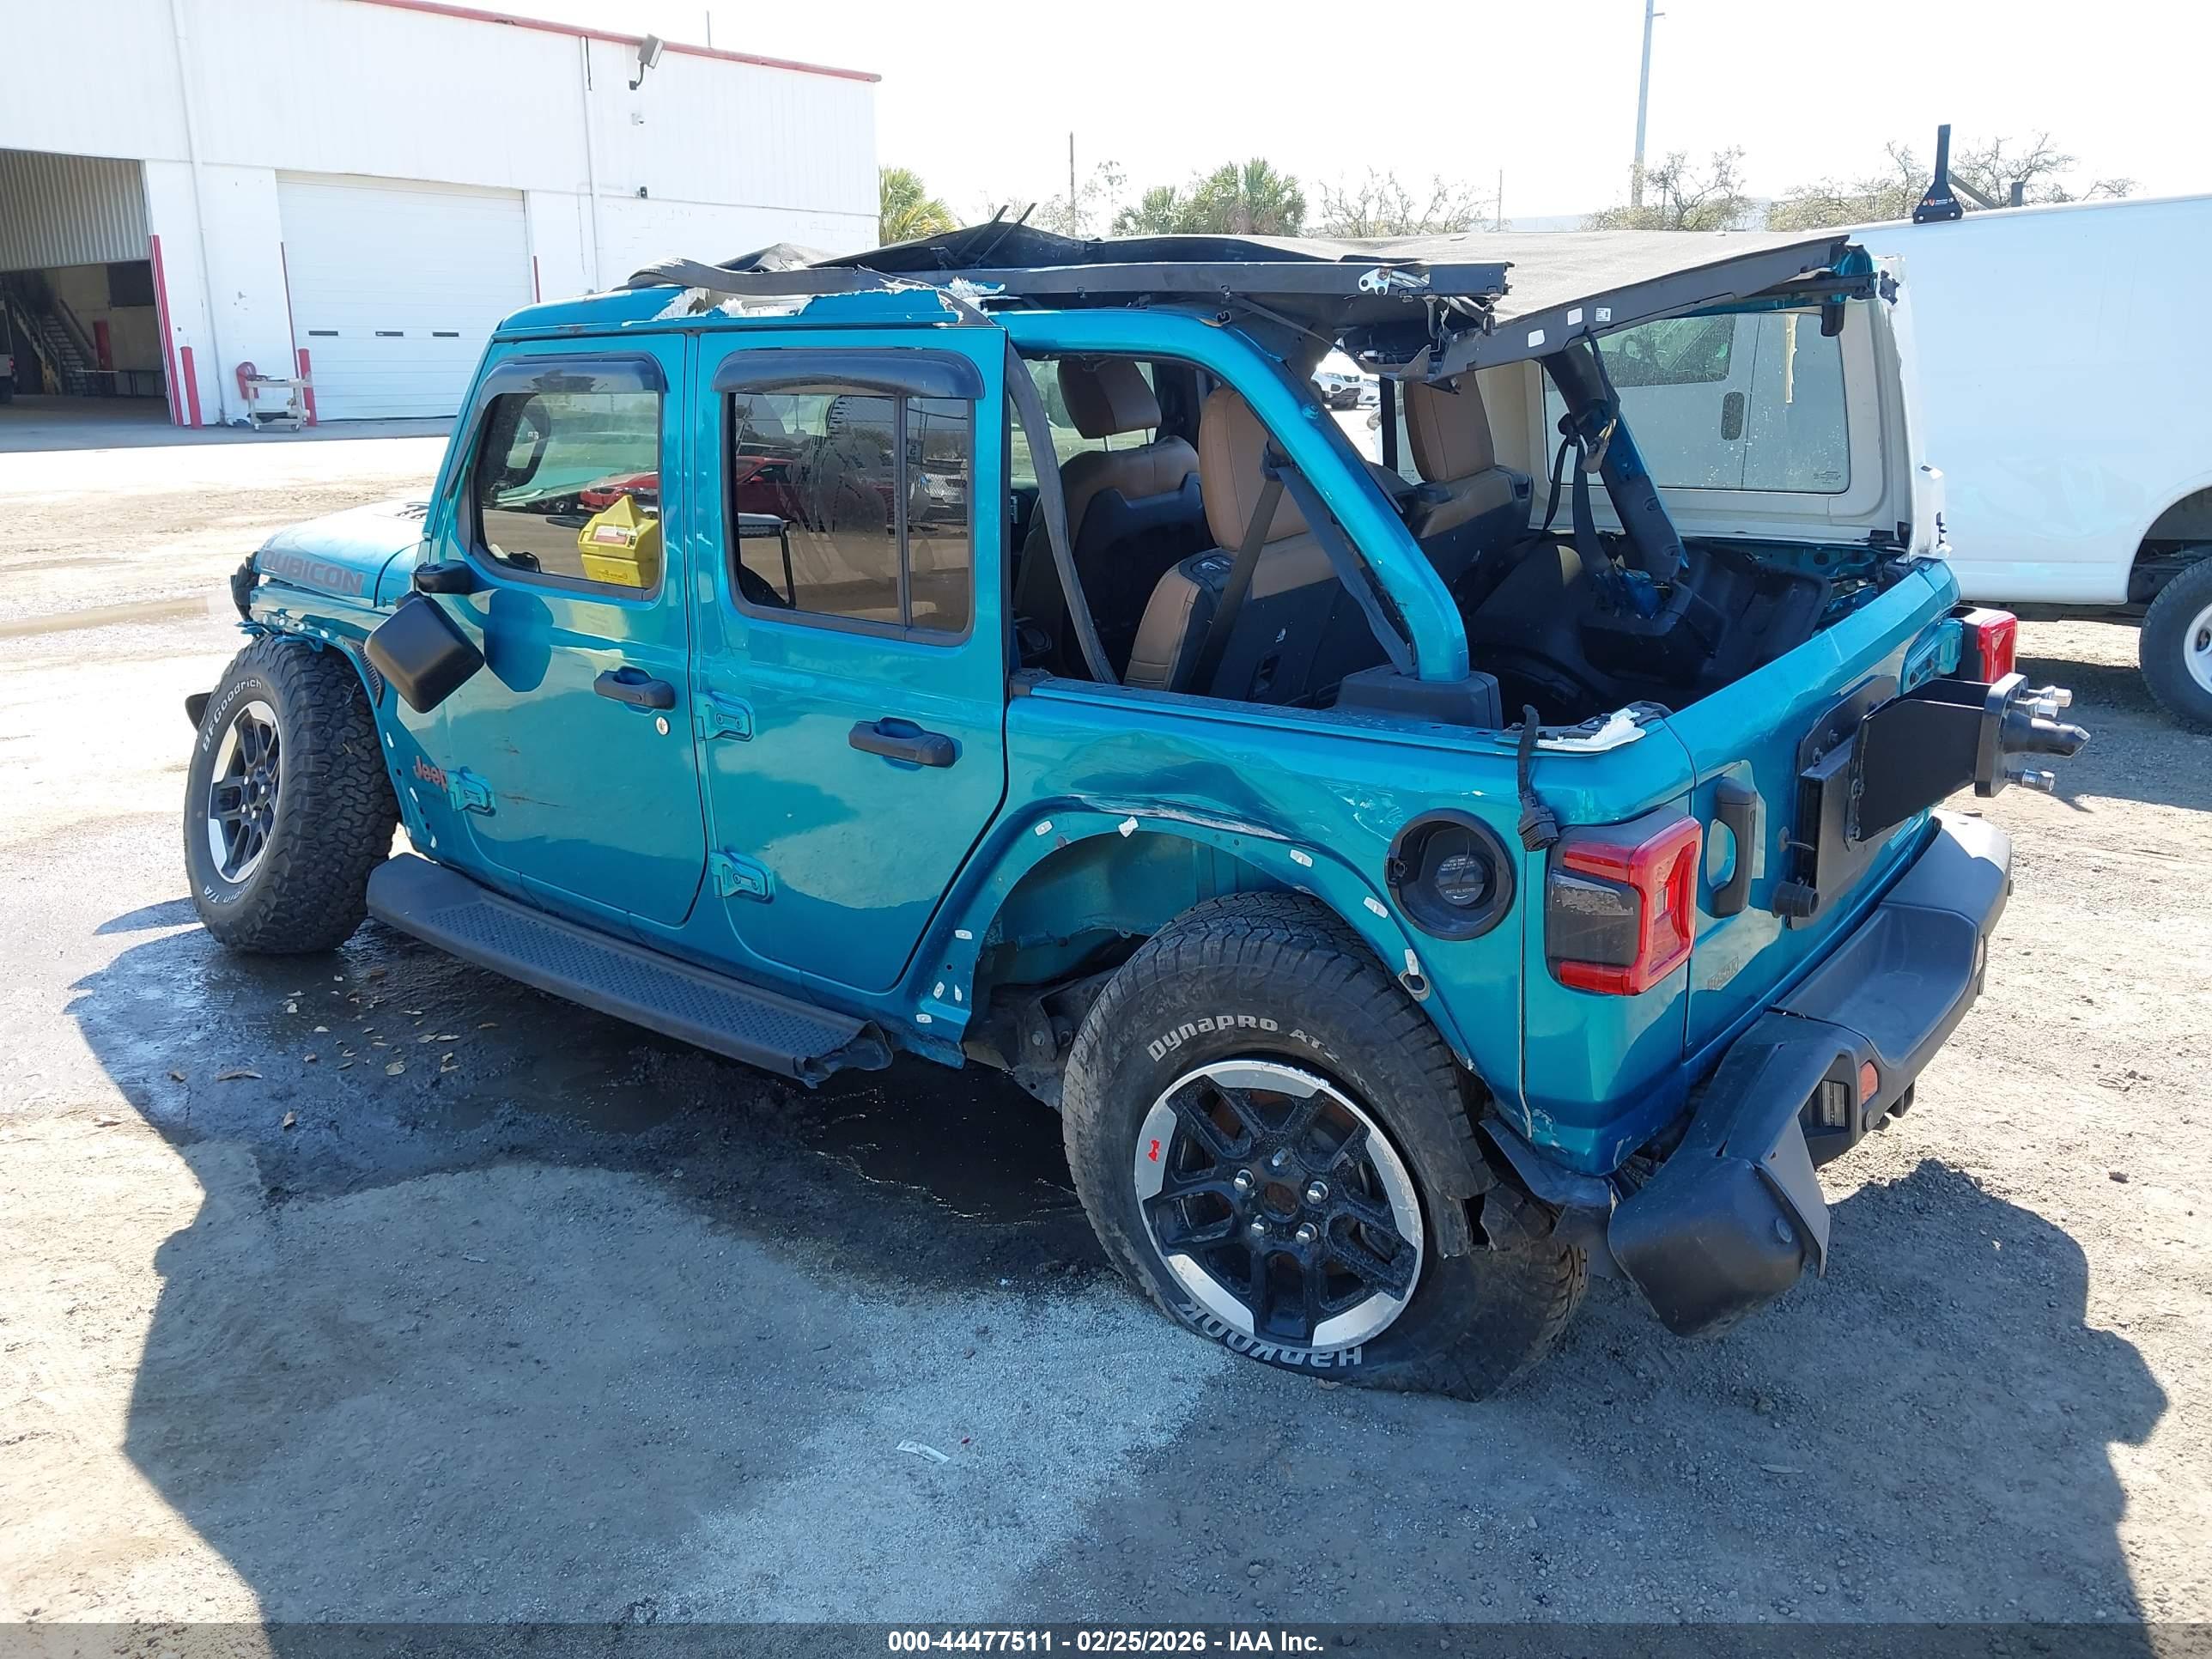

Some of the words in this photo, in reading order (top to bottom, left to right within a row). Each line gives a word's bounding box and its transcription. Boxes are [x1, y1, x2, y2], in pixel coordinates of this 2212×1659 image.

[259, 550, 364, 594] RUBICON
[202, 677, 262, 753] BFGoodrich
[412, 755, 448, 793] Jeep
